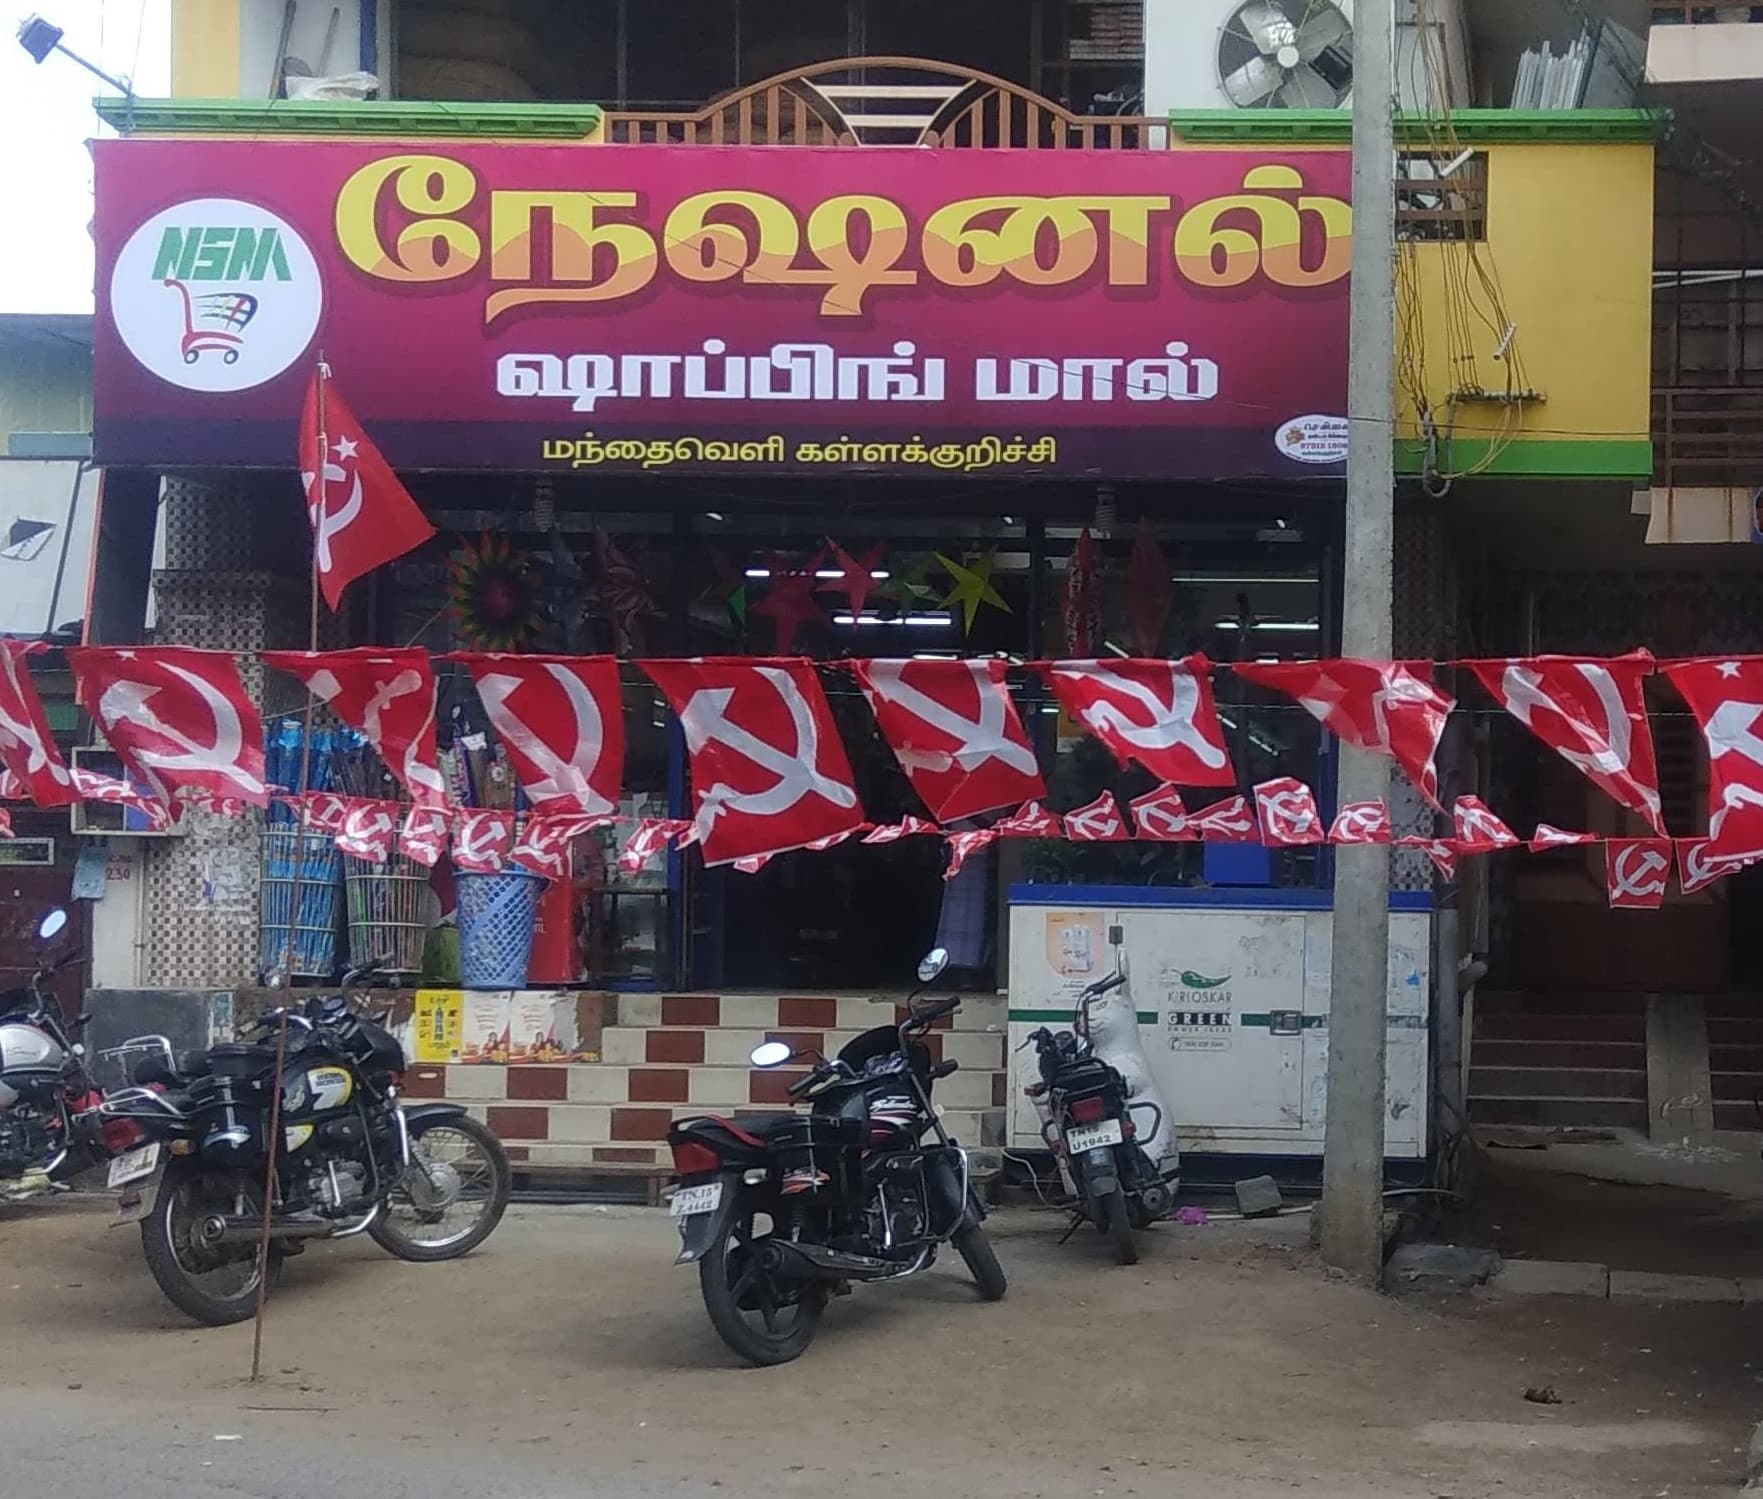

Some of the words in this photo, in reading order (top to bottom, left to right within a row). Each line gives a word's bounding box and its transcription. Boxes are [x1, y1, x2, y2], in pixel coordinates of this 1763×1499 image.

[152, 226, 293, 281] NSM
[335, 155, 1351, 324] நேஷனல்
[496, 340, 946, 412] ஷாப்பிங்
[975, 341, 1219, 401] மால்
[542, 432, 785, 468] மந்தைவெளி
[795, 435, 1057, 471] கள்ளக்குறிச்சி
[1168, 1012, 1232, 1025] GREEN
